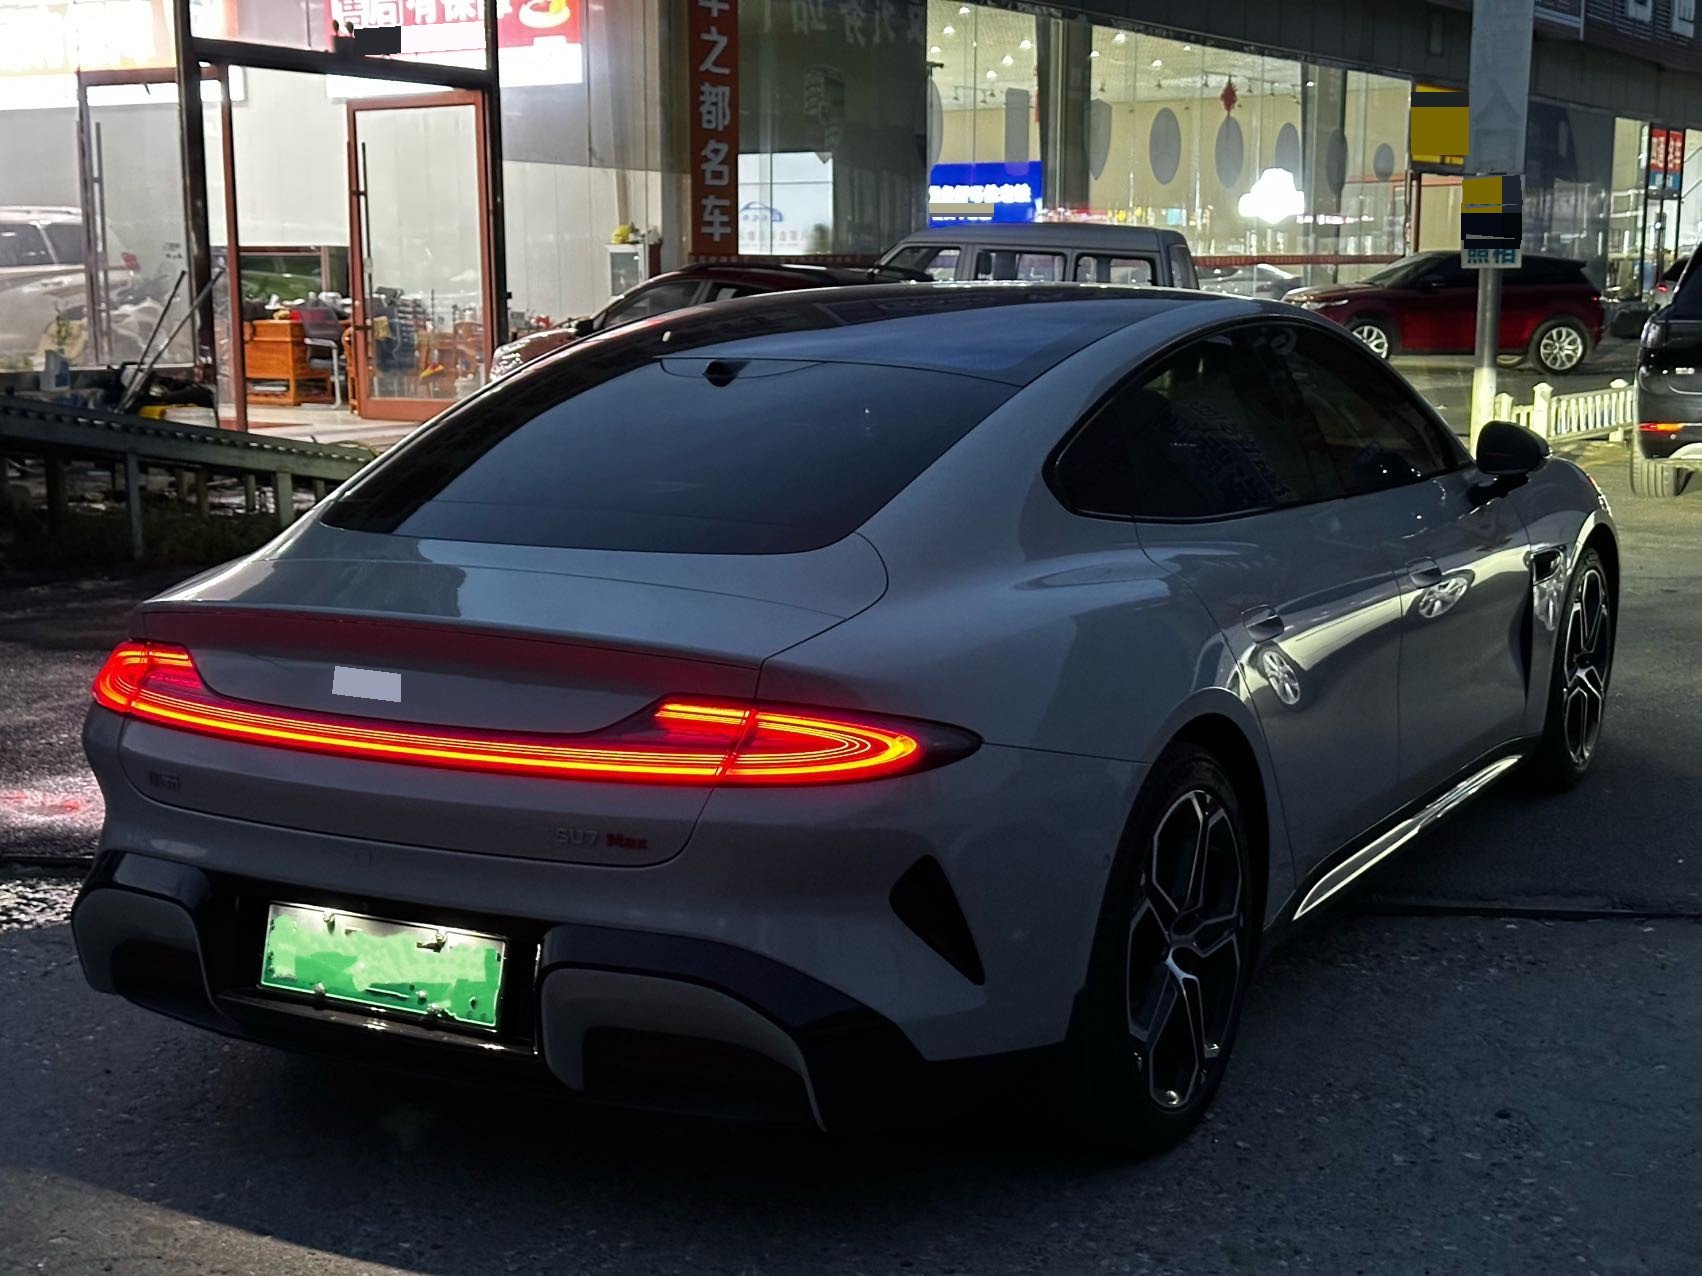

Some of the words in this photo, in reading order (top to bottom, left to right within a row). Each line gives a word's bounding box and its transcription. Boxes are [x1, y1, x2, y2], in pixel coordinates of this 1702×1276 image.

[330, 0, 513, 28] 售后有保
[555, 827, 600, 846] SU7
